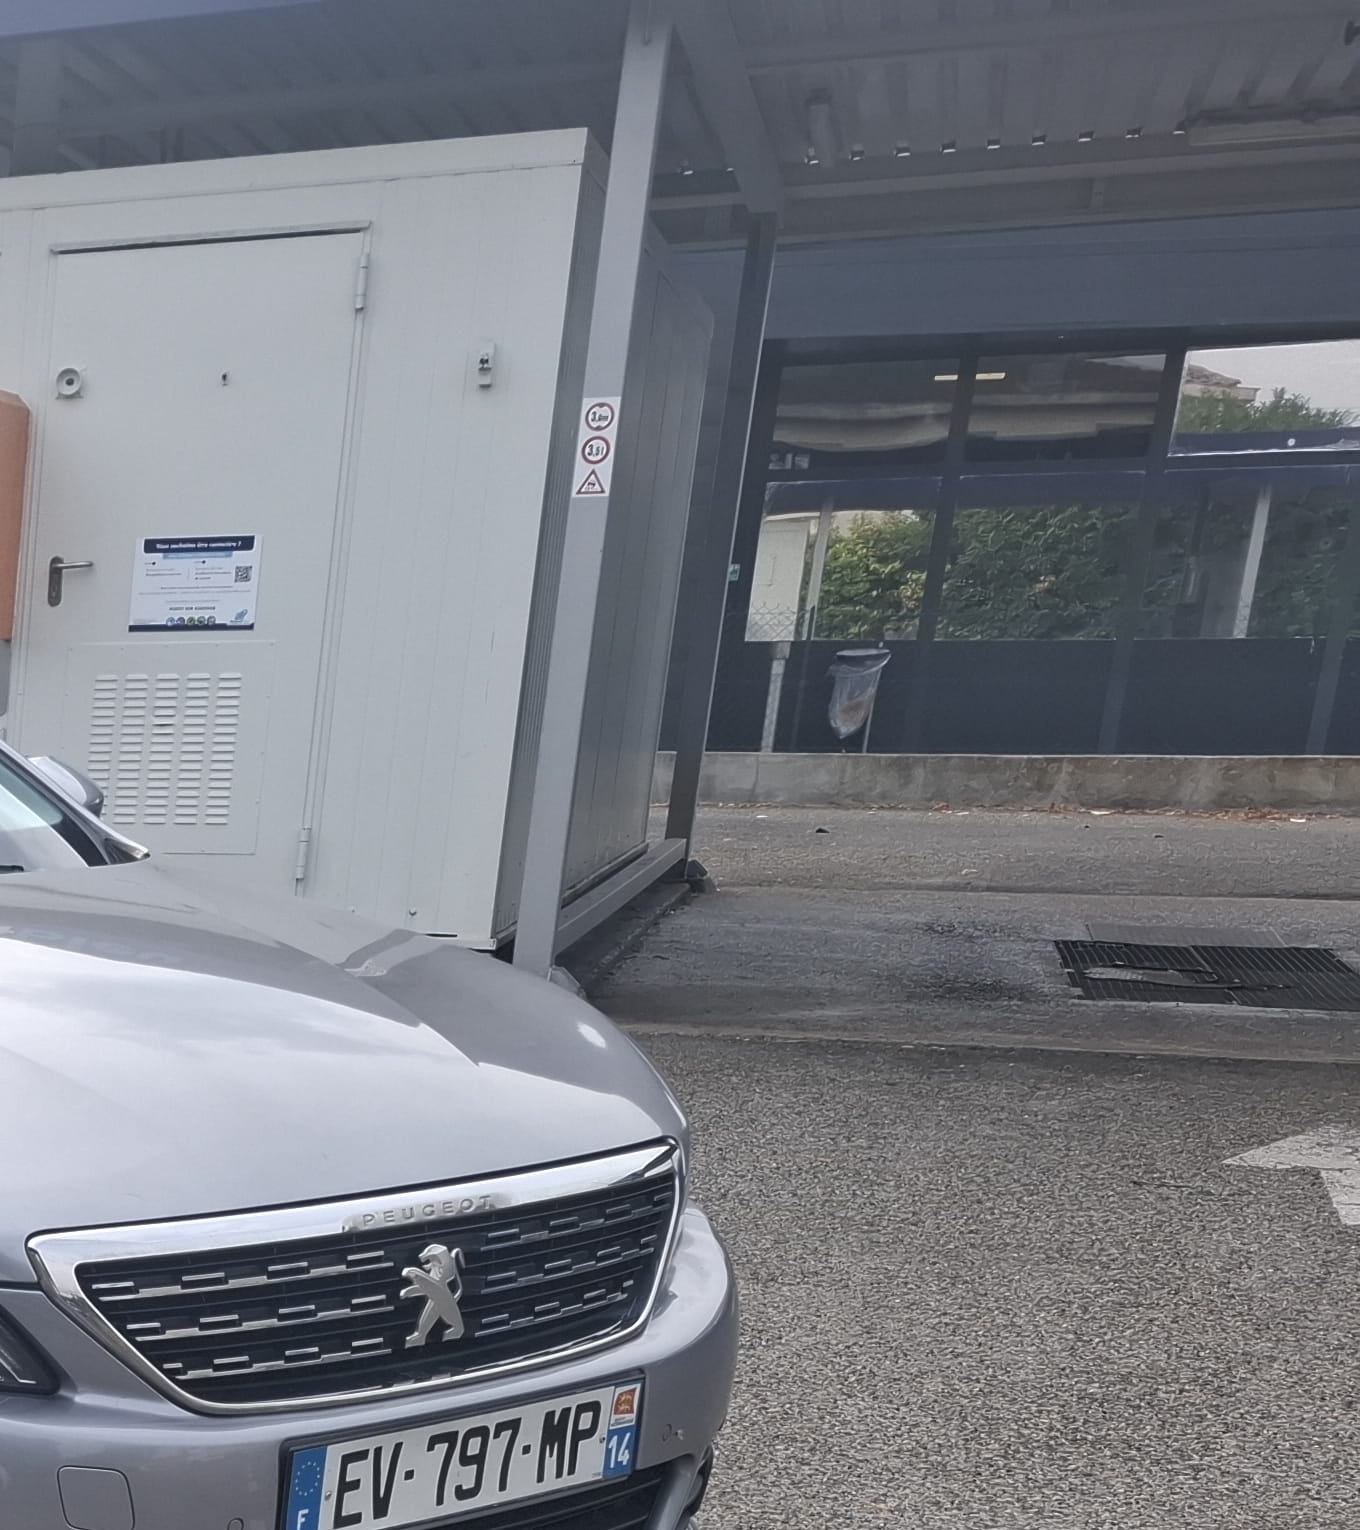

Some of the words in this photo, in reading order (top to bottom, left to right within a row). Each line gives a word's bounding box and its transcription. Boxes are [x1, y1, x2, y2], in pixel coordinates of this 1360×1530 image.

[362, 1195, 491, 1227] PEUGEOT
[333, 1400, 602, 1530] EV-797-MP
[608, 1432, 632, 1468] 14
